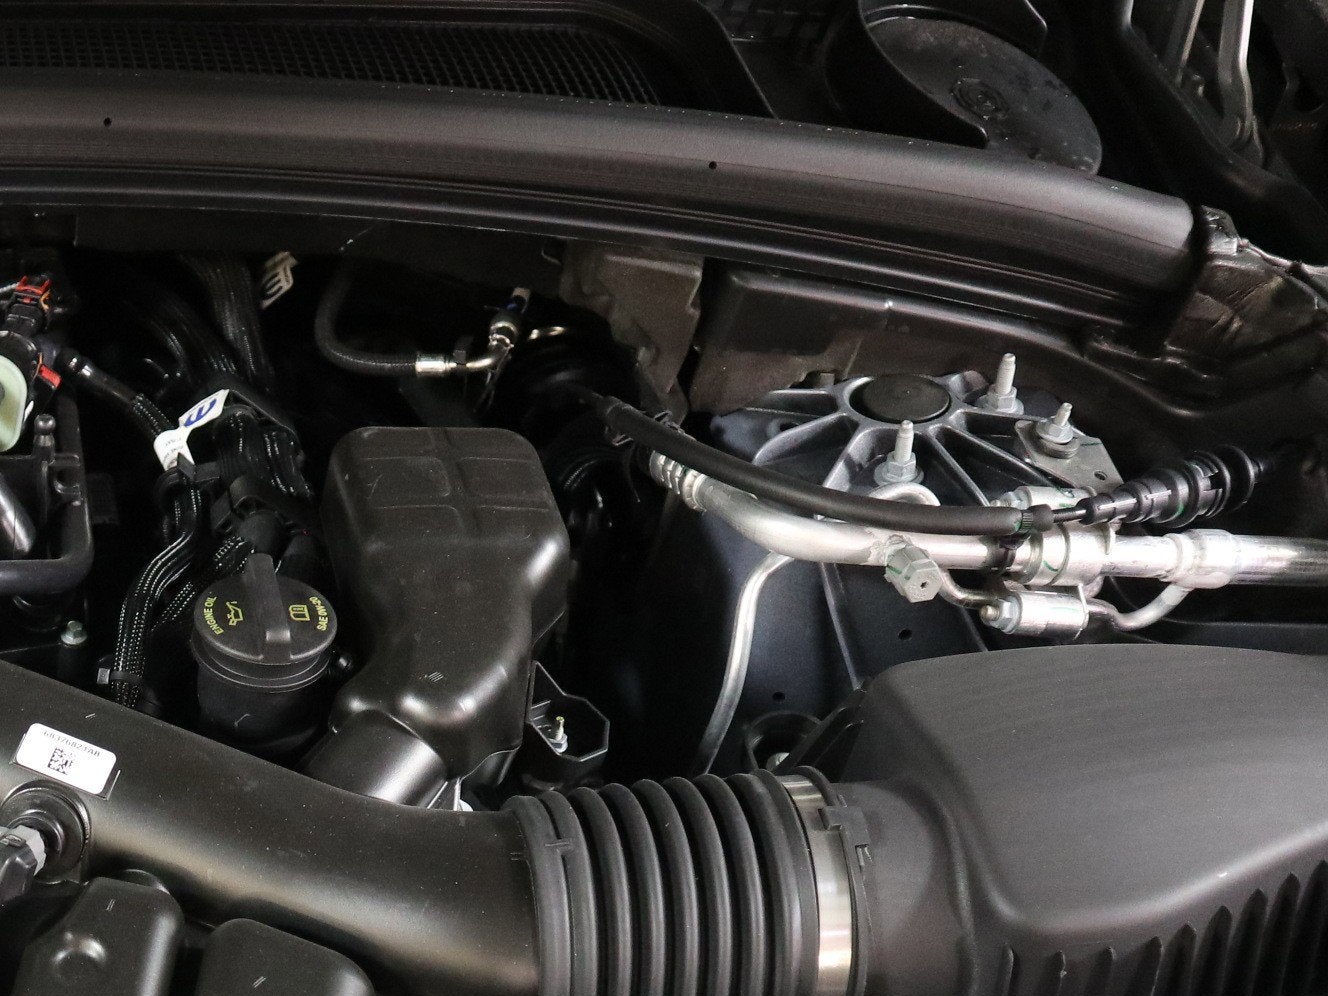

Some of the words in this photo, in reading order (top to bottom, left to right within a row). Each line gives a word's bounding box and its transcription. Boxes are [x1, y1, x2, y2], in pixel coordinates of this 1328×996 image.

[204, 595, 218, 608] OIL
[309, 596, 328, 617] 0W-20
[203, 607, 224, 636] ENGINE
[316, 615, 329, 631] SAE
